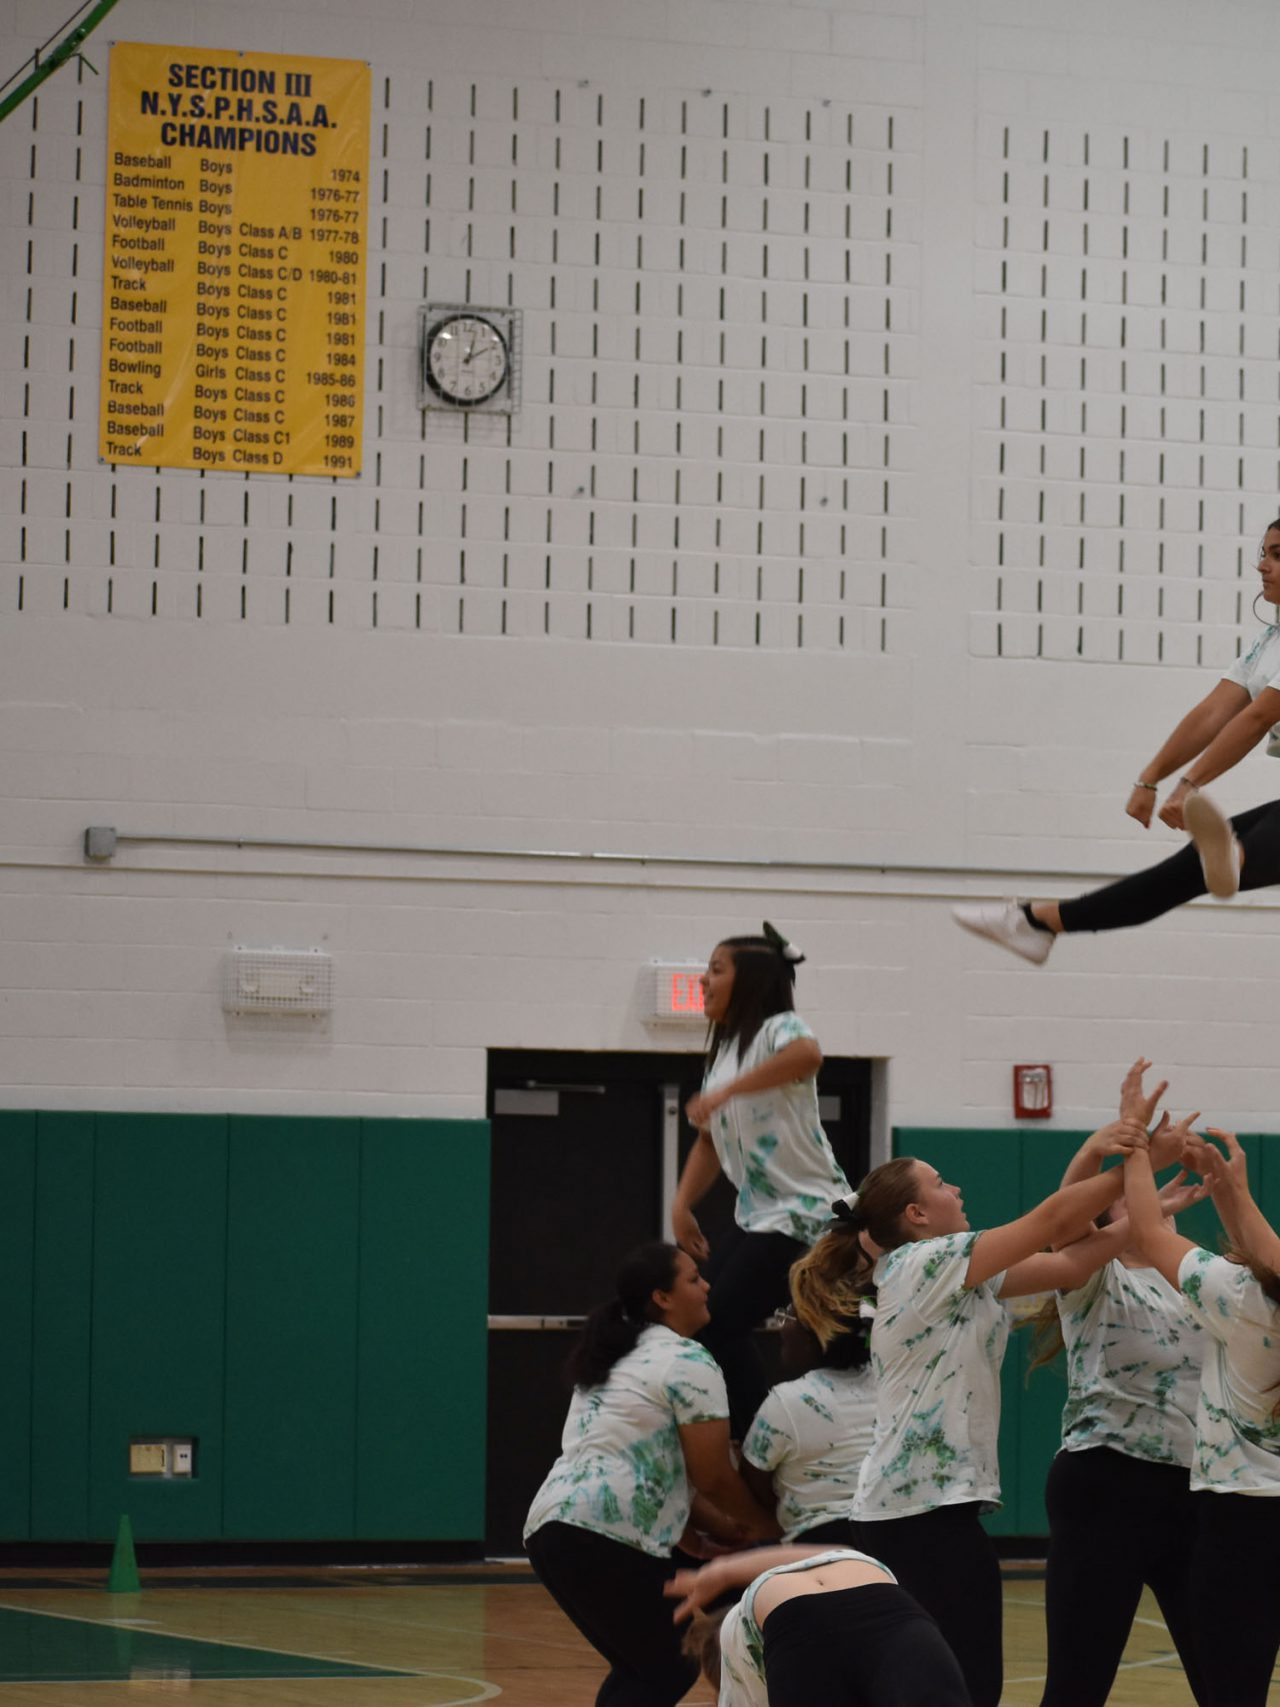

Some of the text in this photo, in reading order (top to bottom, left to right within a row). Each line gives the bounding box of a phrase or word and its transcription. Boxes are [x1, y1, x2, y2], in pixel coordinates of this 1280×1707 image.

[168, 64, 312, 97] SECTION III
[141, 90, 337, 128] N.Y.S.P.H.S.A.A.
[161, 122, 316, 157] CHAMPIONS
[114, 152, 360, 181] Baseball Boys 1974
[113, 173, 360, 202] Badminton Boys 1976-77
[113, 194, 359, 222] Table Tennis Boys 1976-77
[112, 214, 175, 232] Volleyball
[198, 221, 232, 236] Boys
[239, 224, 274, 238] Class
[310, 229, 359, 244] 1977-78
[112, 234, 359, 264] Football Boys Class C 1980
[112, 255, 356, 284] Volleyball Boys Class C/D 1980-81
[111, 276, 356, 304] Track Boys Class C 1981
[110, 297, 356, 325] Baseball Boys Class C 1981
[110, 317, 355, 346] Football Boys Class C 1981
[109, 338, 356, 366] Football Boys Class C 1984
[109, 359, 356, 387] Bowling Girls Class C 1985-86
[108, 380, 355, 407] Track Boys Class C 1986
[107, 401, 355, 427] Baseball Boys Class C 1987
[107, 422, 354, 448] Baseball Boys Class C1 1989
[106, 442, 352, 468] Track Boys Class D 1991
